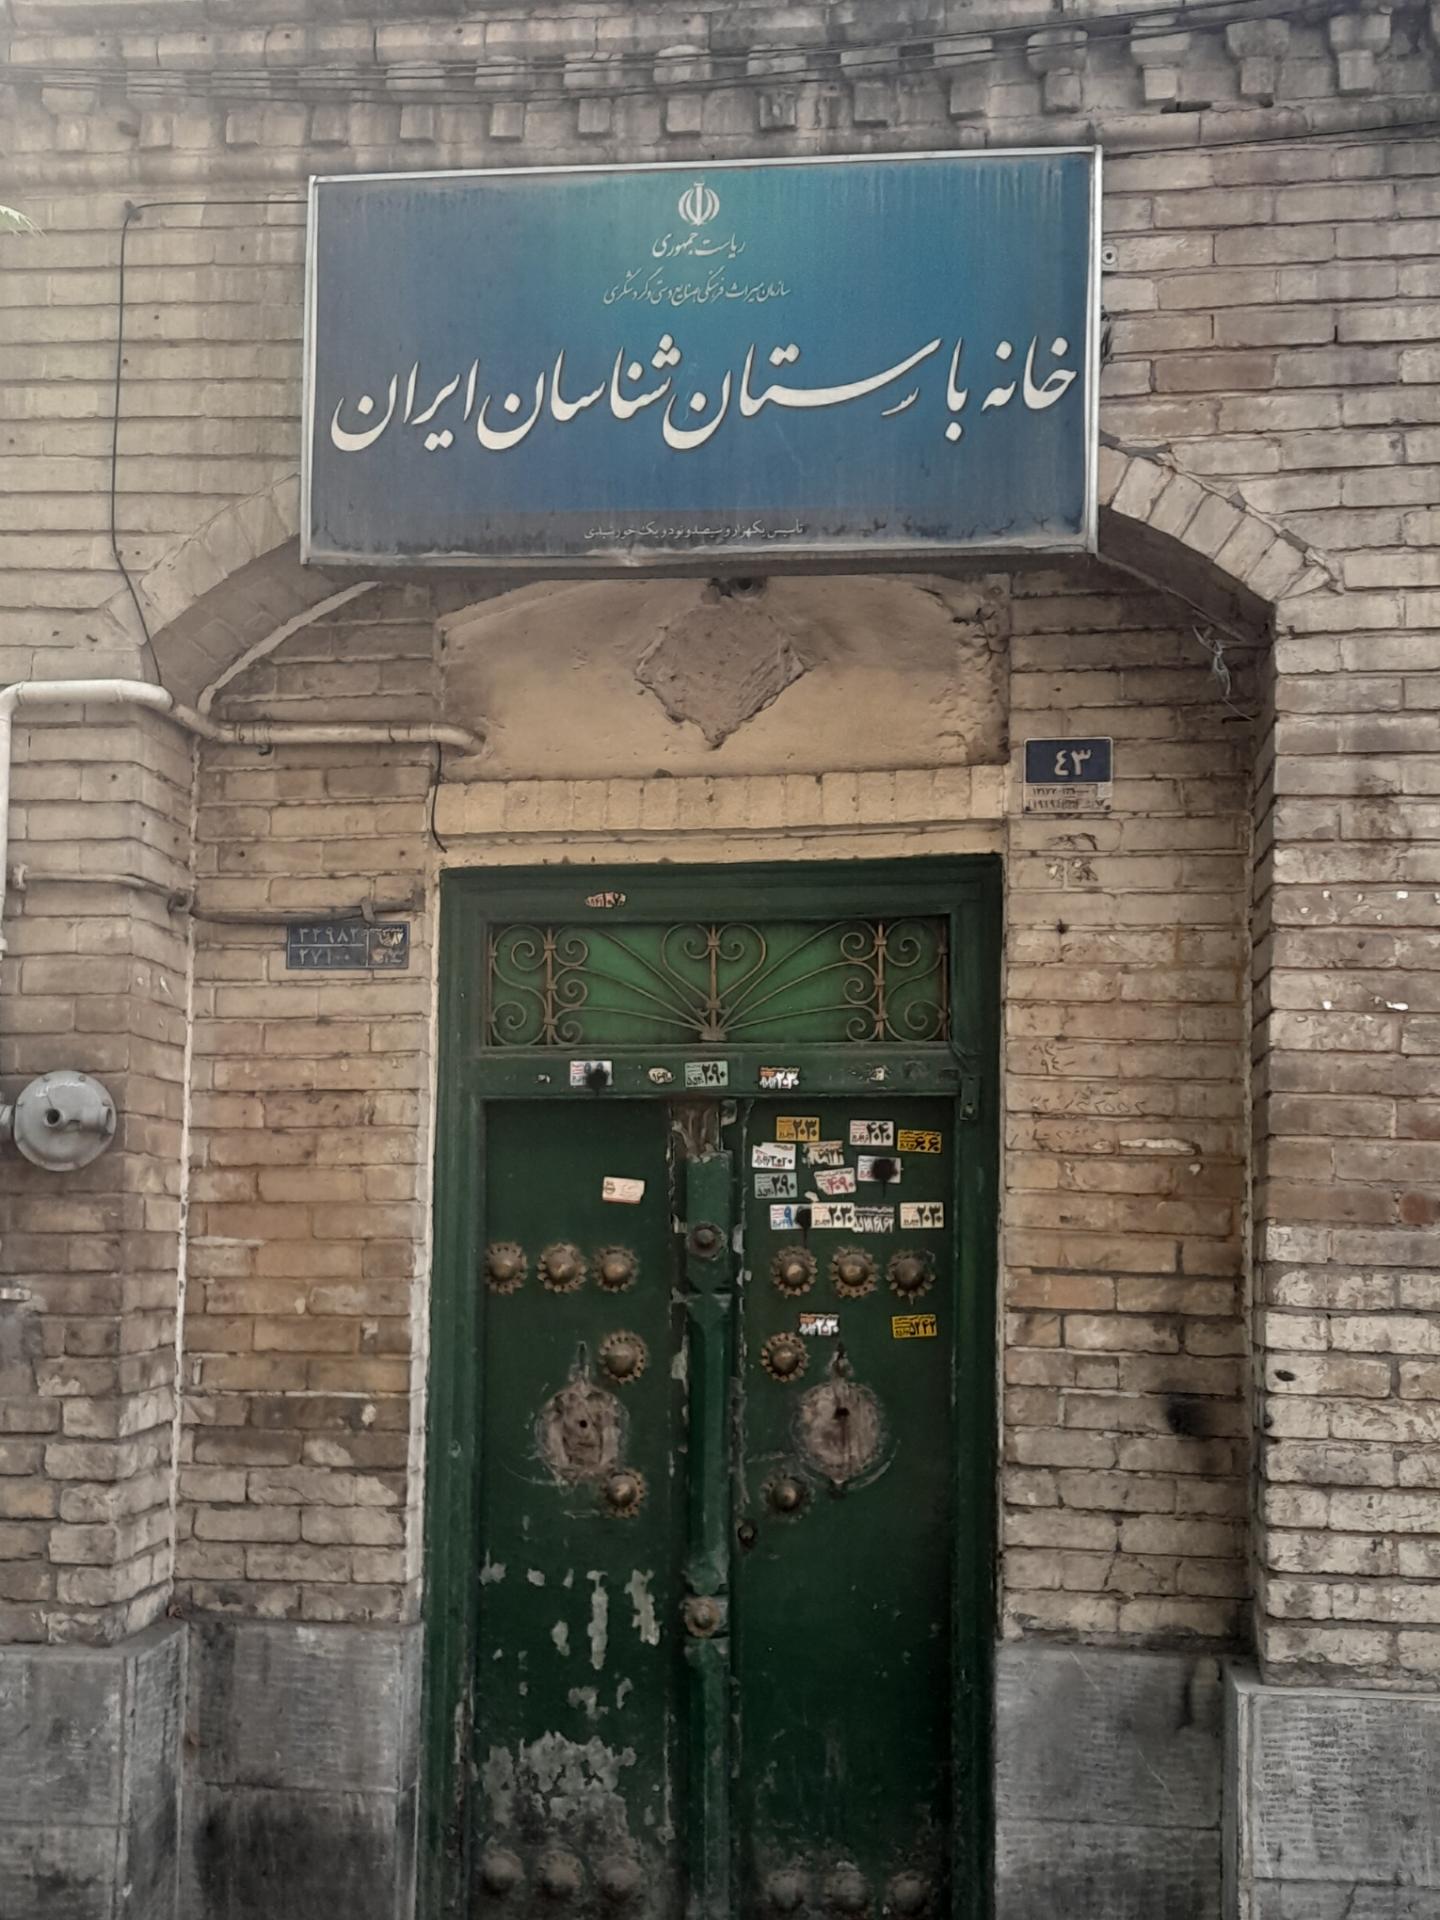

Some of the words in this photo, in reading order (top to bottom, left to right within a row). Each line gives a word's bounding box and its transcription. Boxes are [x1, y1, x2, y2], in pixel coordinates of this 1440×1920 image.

[652, 232, 698, 257] جمهوری
[695, 233, 745, 258] ریاست
[725, 281, 765, 302] میراث
[756, 280, 791, 302] سازمان
[980, 335, 1078, 413] خانه
[330, 357, 480, 452] ایران
[476, 333, 682, 451] شناسان
